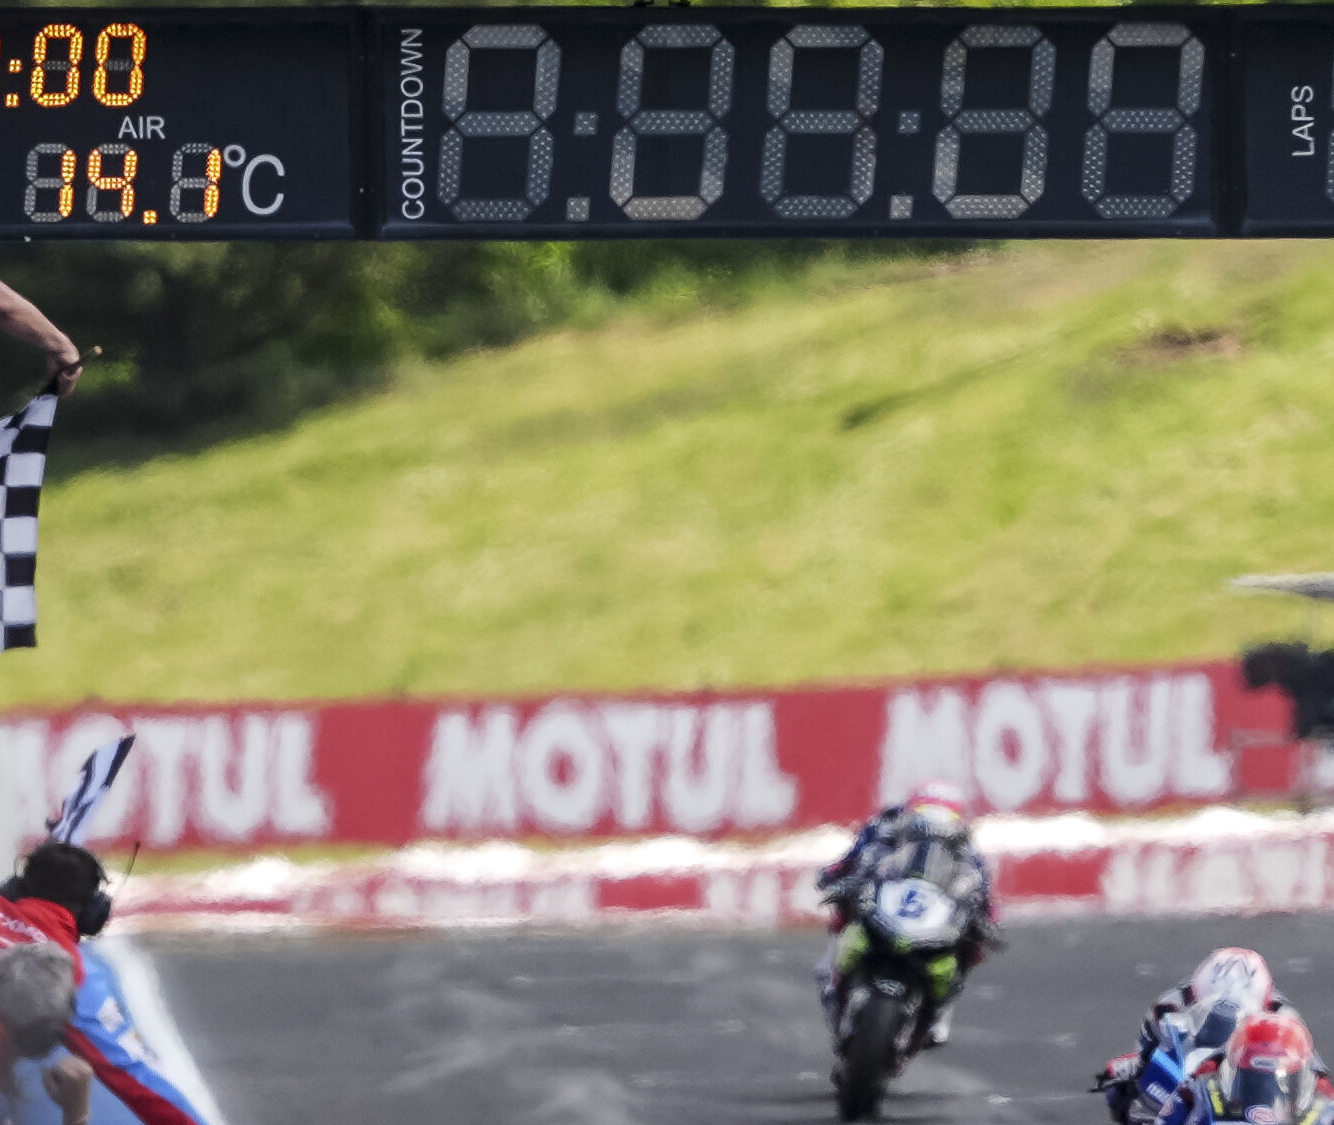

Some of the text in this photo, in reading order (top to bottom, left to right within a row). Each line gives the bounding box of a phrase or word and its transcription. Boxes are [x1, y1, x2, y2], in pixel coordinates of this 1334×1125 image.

[118, 117, 166, 140] AIR
[400, 28, 424, 220] COUNTDOWN
[1290, 85, 1316, 158] LAPS
[420, 698, 800, 834] MOTUL
[876, 671, 1234, 812] MOTUL
